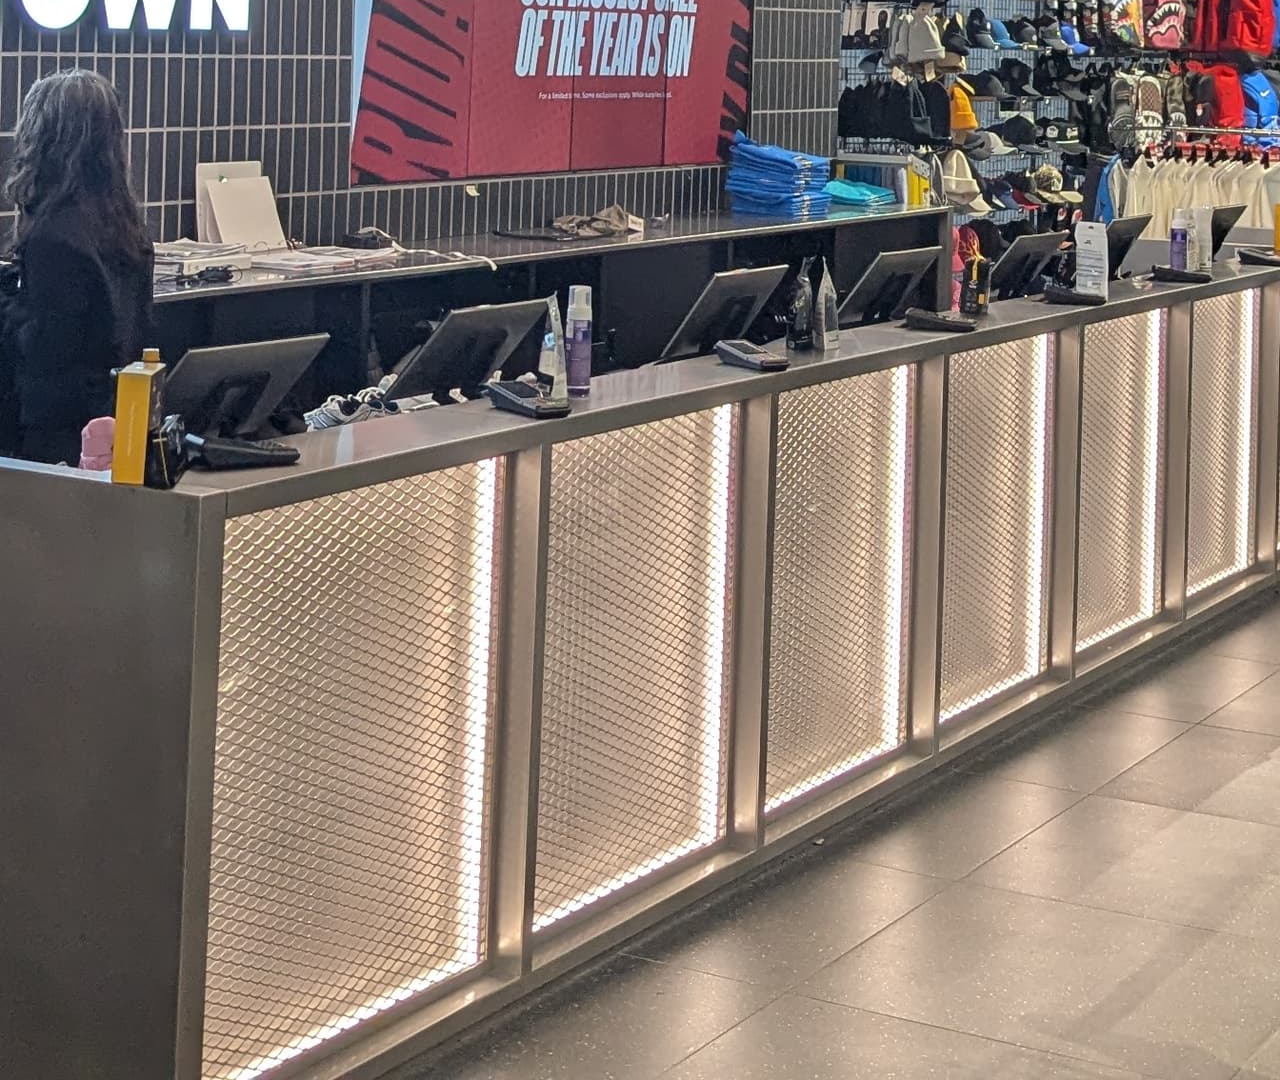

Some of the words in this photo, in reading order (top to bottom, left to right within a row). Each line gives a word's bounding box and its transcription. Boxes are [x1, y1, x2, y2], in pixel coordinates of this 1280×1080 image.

[515, 8, 548, 77] OF
[546, 10, 589, 77] THE
[589, 11, 643, 77] YEAR
[640, 14, 665, 77] IS
[664, 15, 696, 77] ON
